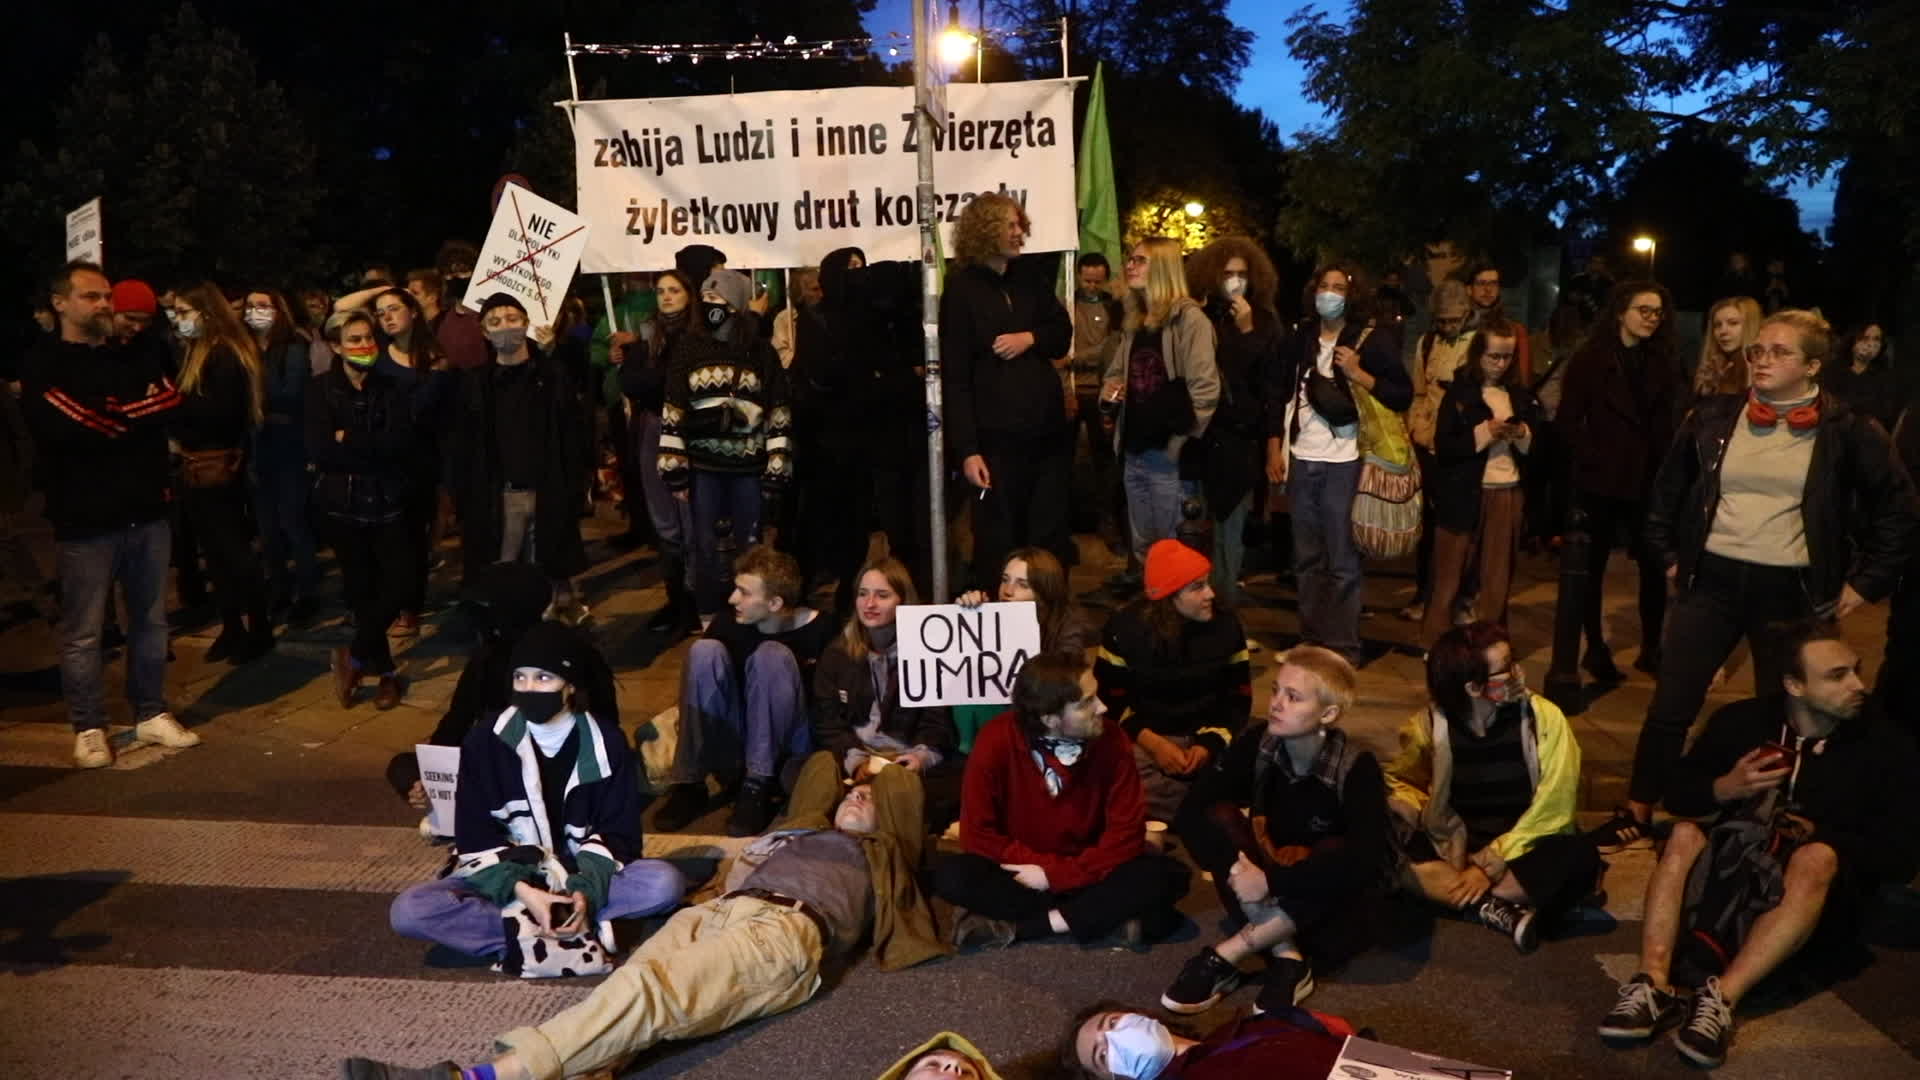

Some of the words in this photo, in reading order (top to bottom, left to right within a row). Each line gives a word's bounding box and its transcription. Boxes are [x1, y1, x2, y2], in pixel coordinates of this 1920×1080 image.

[594, 128, 684, 176] zabija
[696, 119, 775, 164] Ludzi
[791, 118, 799, 157] i
[816, 117, 887, 156] inne
[625, 197, 779, 241] żyletkowy
[794, 190, 861, 231] drut
[875, 183, 1027, 227] kolczy
[508, 229, 525, 243] DLA
[528, 213, 557, 240] NIE
[920, 612, 1001, 653] ONI
[424, 771, 454, 783] SEEKING
[429, 788, 437, 799] IS
